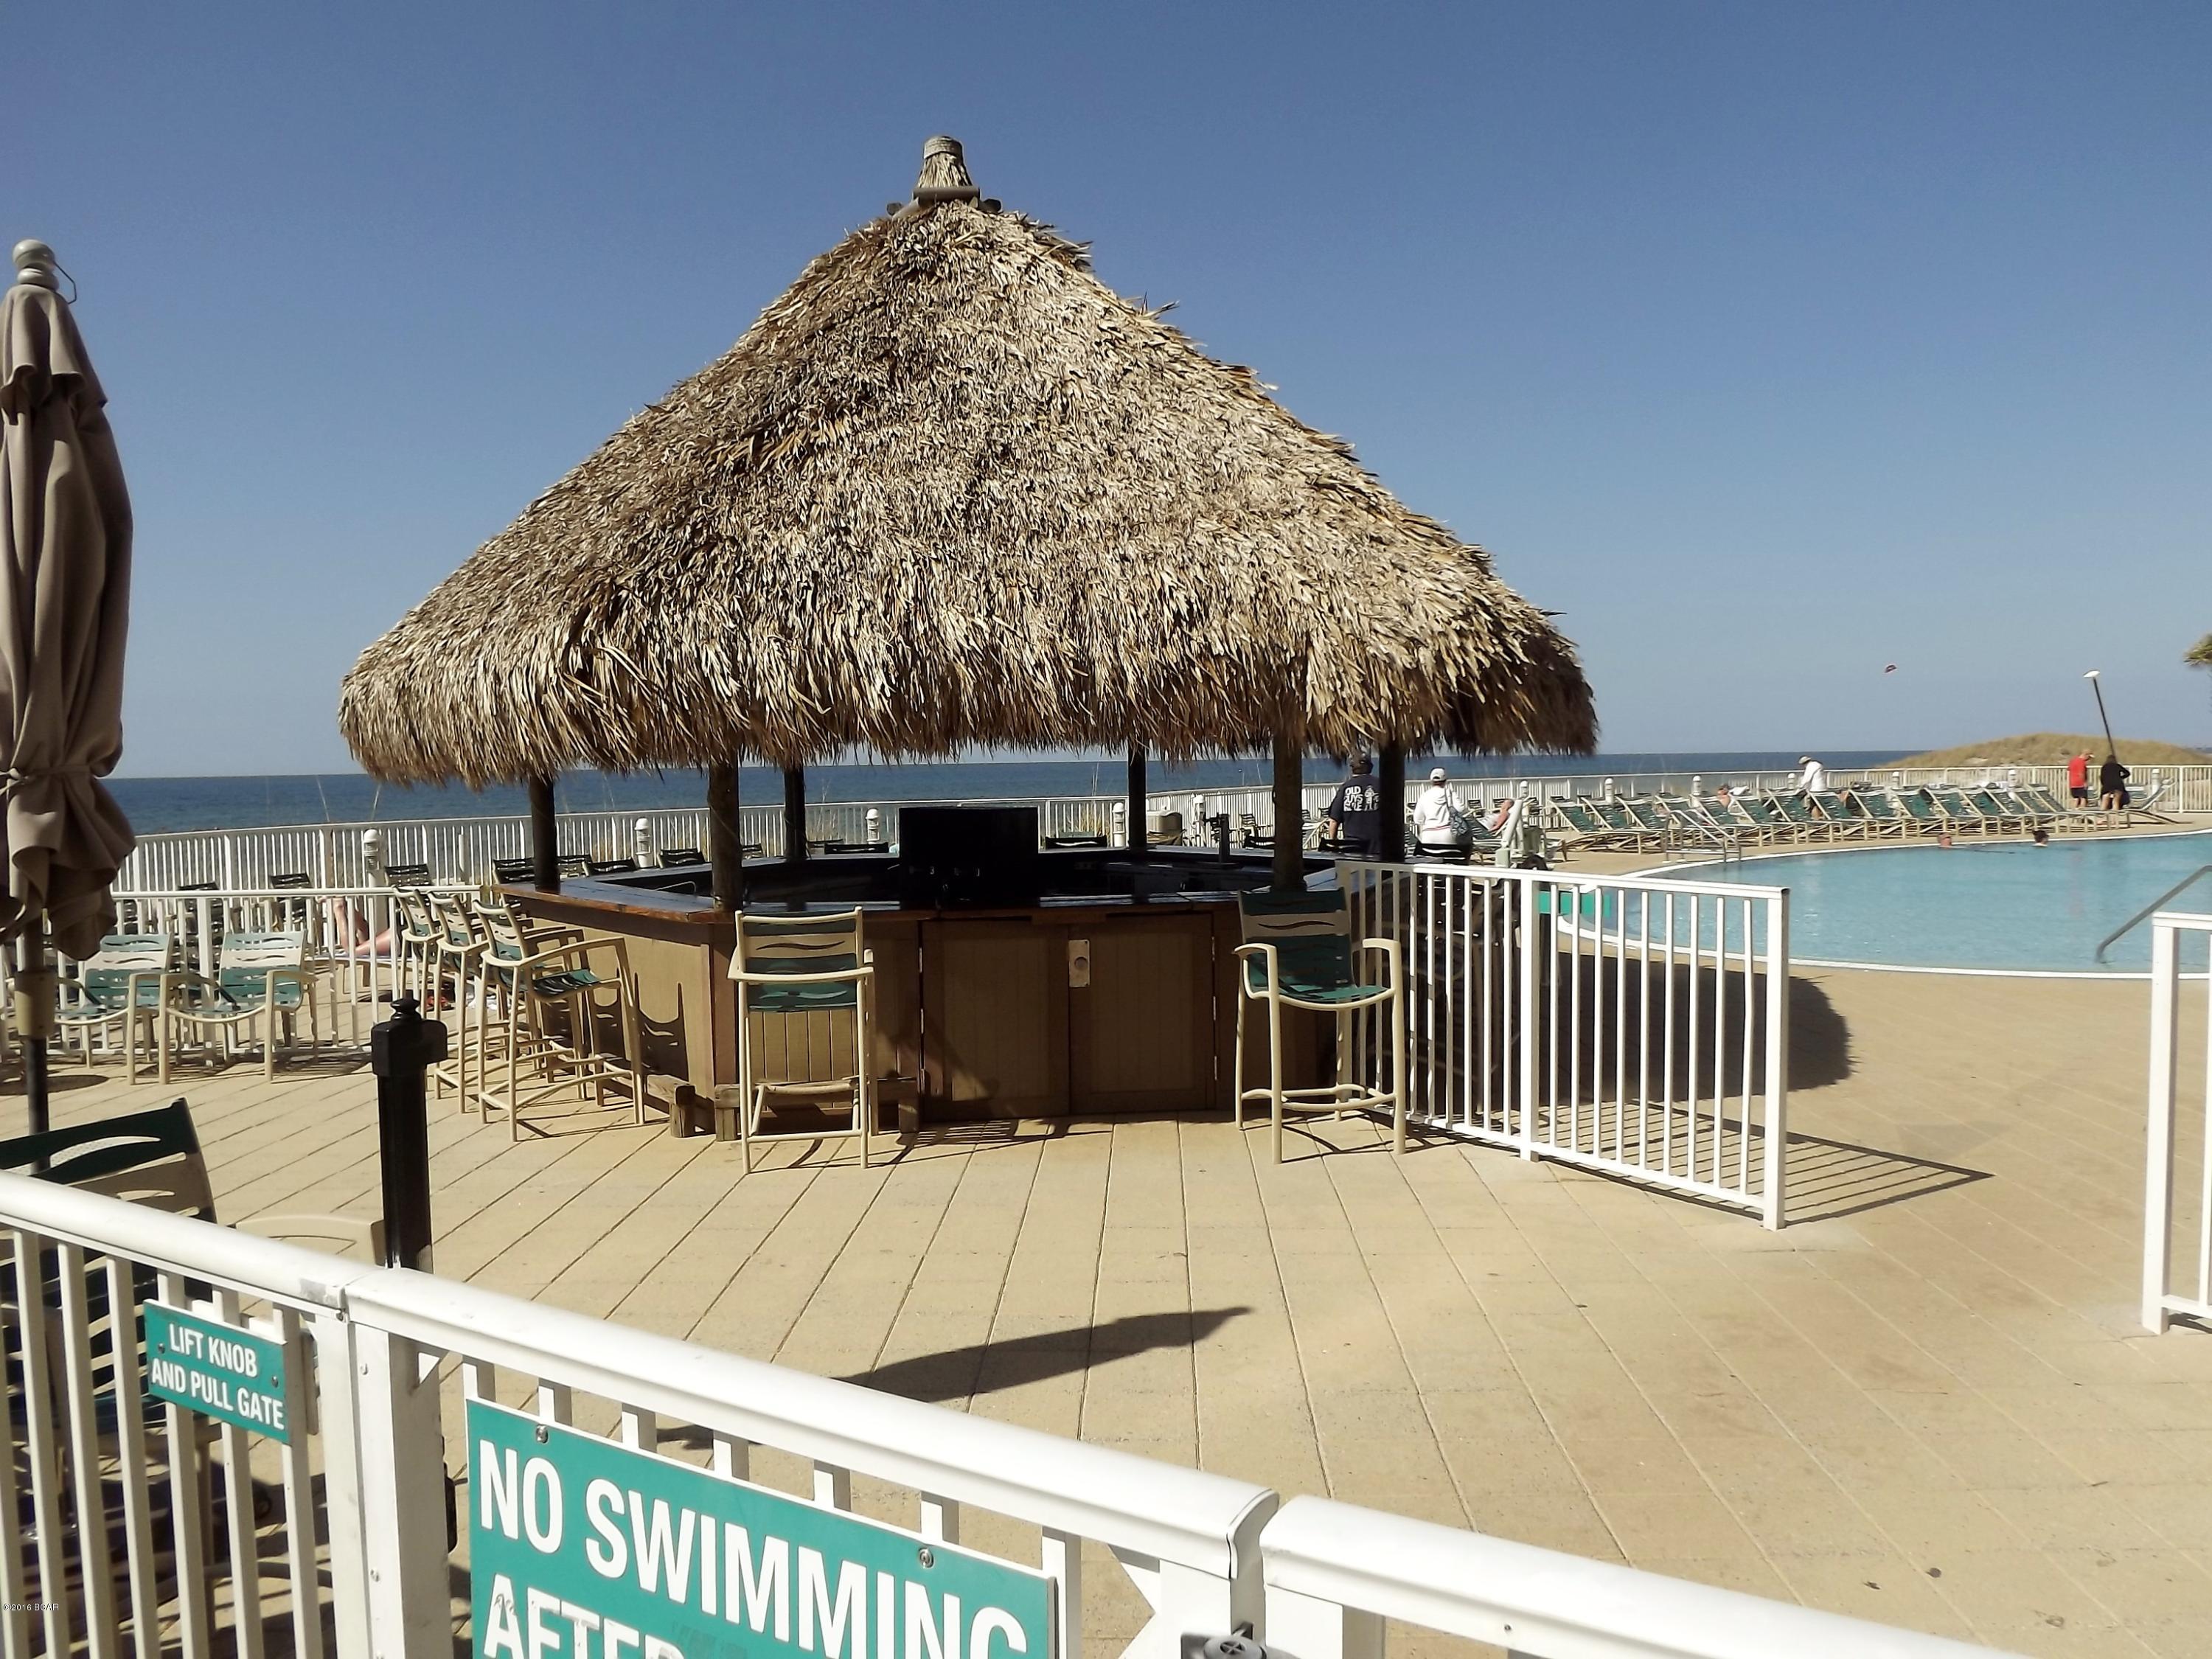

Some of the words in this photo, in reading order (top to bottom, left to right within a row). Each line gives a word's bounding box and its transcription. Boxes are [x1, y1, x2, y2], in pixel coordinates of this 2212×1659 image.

[1345, 786, 1362, 796] OLD
[169, 1324, 204, 1359] LIFT
[208, 1336, 257, 1377] KNOB
[152, 1358, 186, 1393] AND
[190, 1371, 234, 1411] PULL
[237, 1388, 285, 1430] GATE
[479, 1439, 563, 1554] NO
